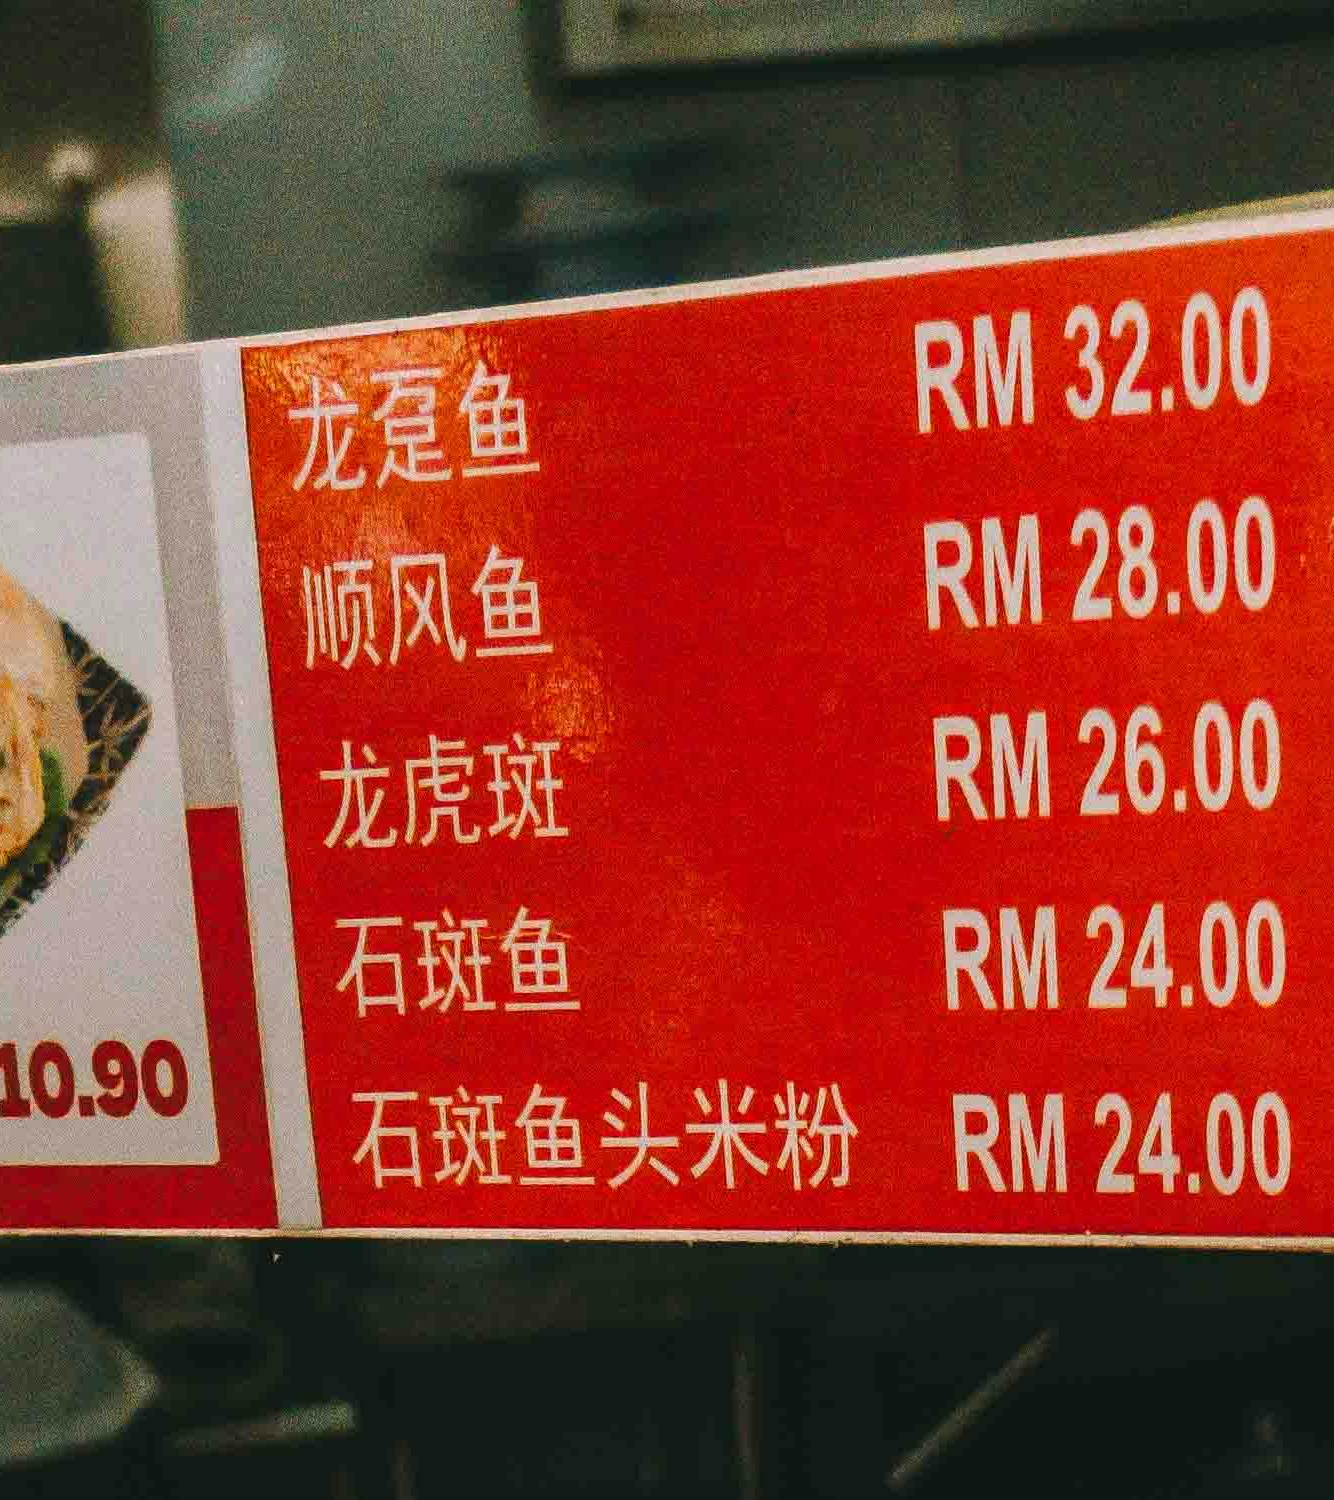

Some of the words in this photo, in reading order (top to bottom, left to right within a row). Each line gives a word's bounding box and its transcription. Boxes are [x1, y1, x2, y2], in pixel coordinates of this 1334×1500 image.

[914, 312, 1035, 433] RM
[1063, 287, 1272, 420] 32.00
[288, 360, 540, 491] 龙趸鱼
[303, 544, 554, 671] 顺风鱼
[924, 515, 1043, 630] RM
[1070, 497, 1276, 622] 28.00
[320, 732, 569, 849] 龙虎斑
[934, 711, 1051, 821] RM
[1079, 699, 1282, 815] 26.00
[335, 905, 581, 1017] 石斑鱼
[943, 906, 1059, 1012] RM
[1086, 900, 1287, 1009] 24.00
[352, 1078, 858, 1190] 石斑鱼头米粉
[953, 1093, 1067, 1194] RM
[1095, 1092, 1292, 1196] 24.00
